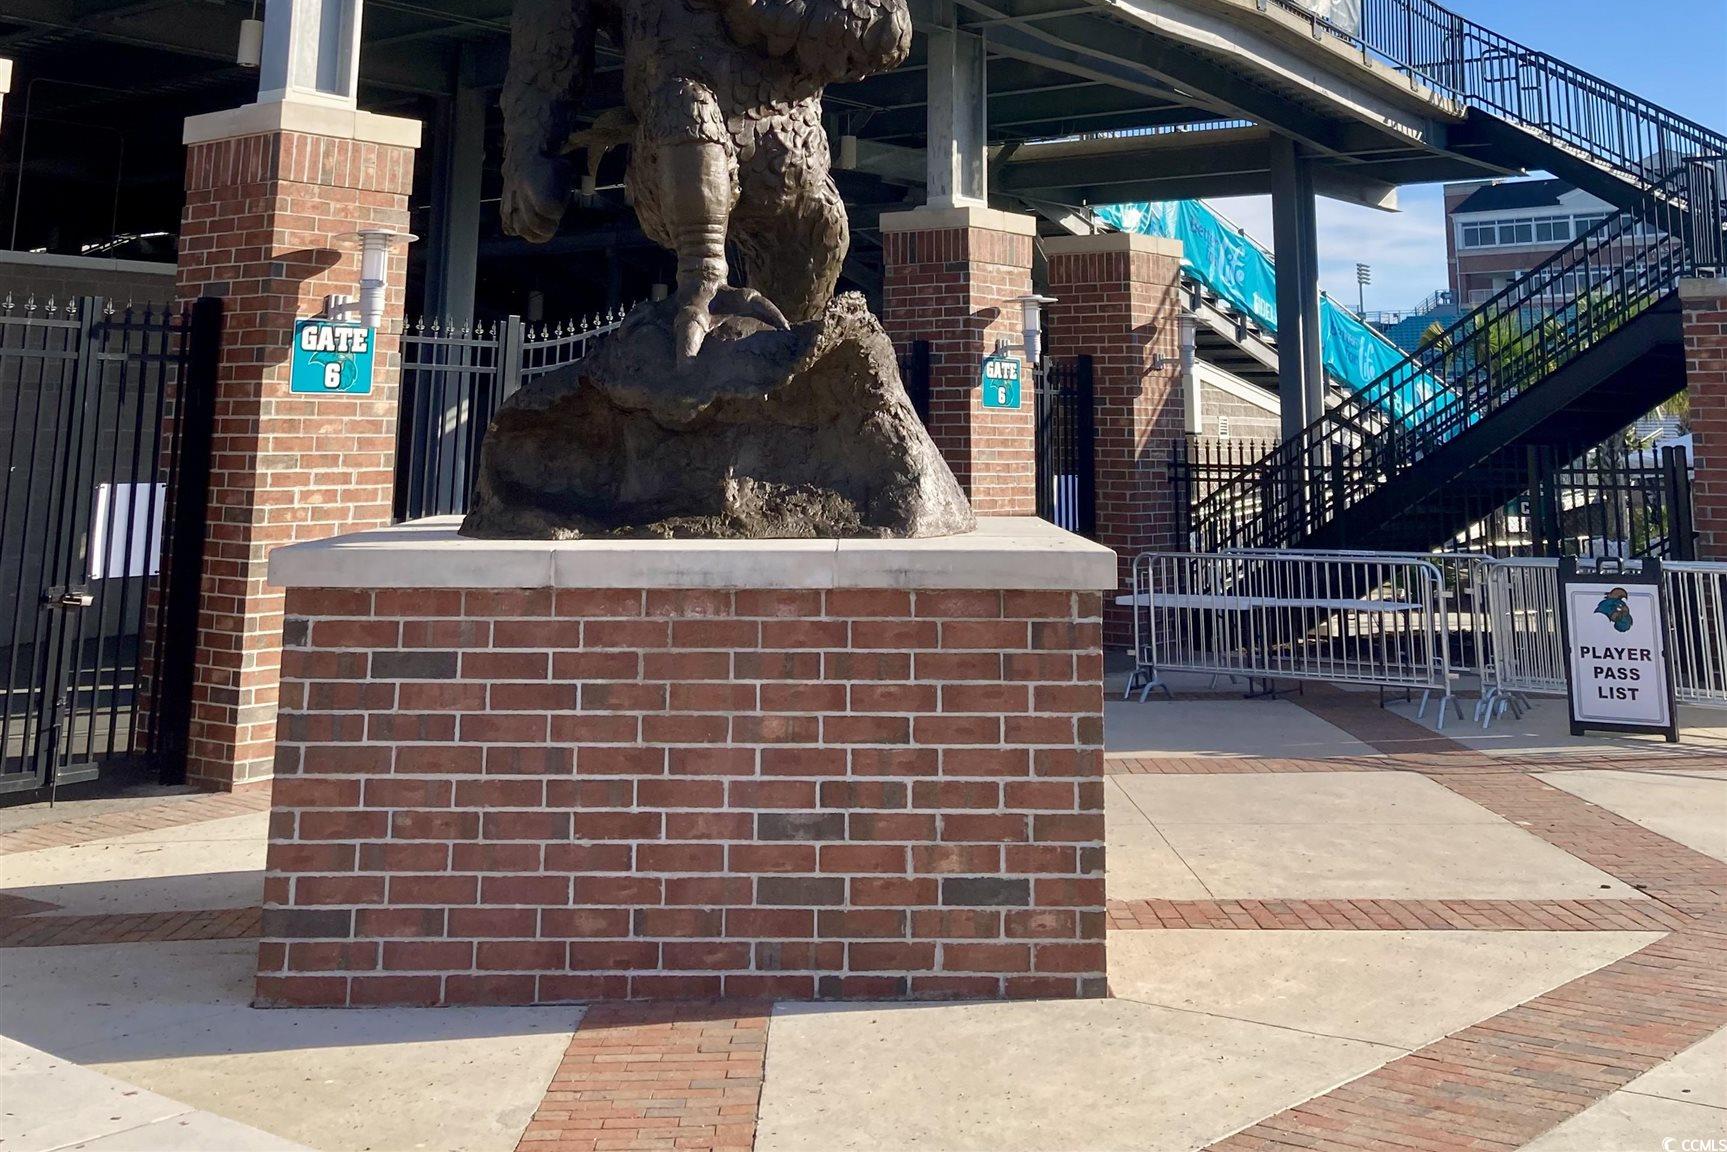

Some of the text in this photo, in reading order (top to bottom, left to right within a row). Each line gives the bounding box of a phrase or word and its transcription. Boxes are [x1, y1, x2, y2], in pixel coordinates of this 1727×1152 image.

[301, 325, 369, 353] GATE
[324, 362, 341, 388] 6
[986, 360, 1018, 380] GATE
[998, 386, 1006, 404] 6
[1579, 645, 1652, 662] PLAYER
[1593, 665, 1641, 681] PASS
[1598, 685, 1639, 701] LIST
